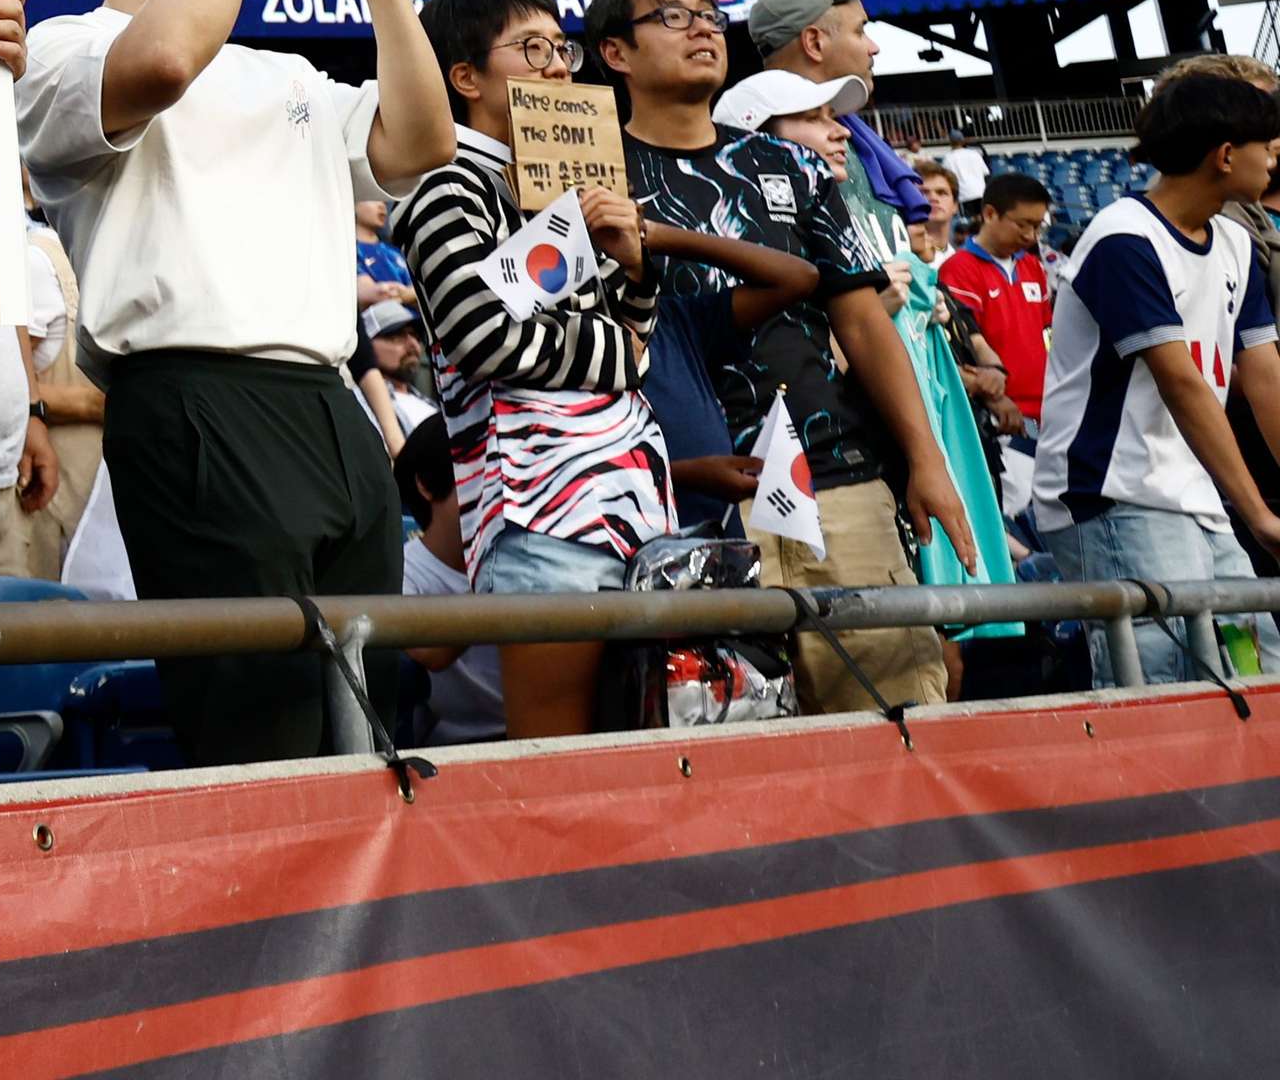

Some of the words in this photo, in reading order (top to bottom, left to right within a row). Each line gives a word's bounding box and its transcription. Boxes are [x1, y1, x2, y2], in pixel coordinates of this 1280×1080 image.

[512, 87, 551, 112] Here
[554, 99, 599, 117] comes
[520, 126, 548, 143] The
[552, 124, 596, 147] SON!
